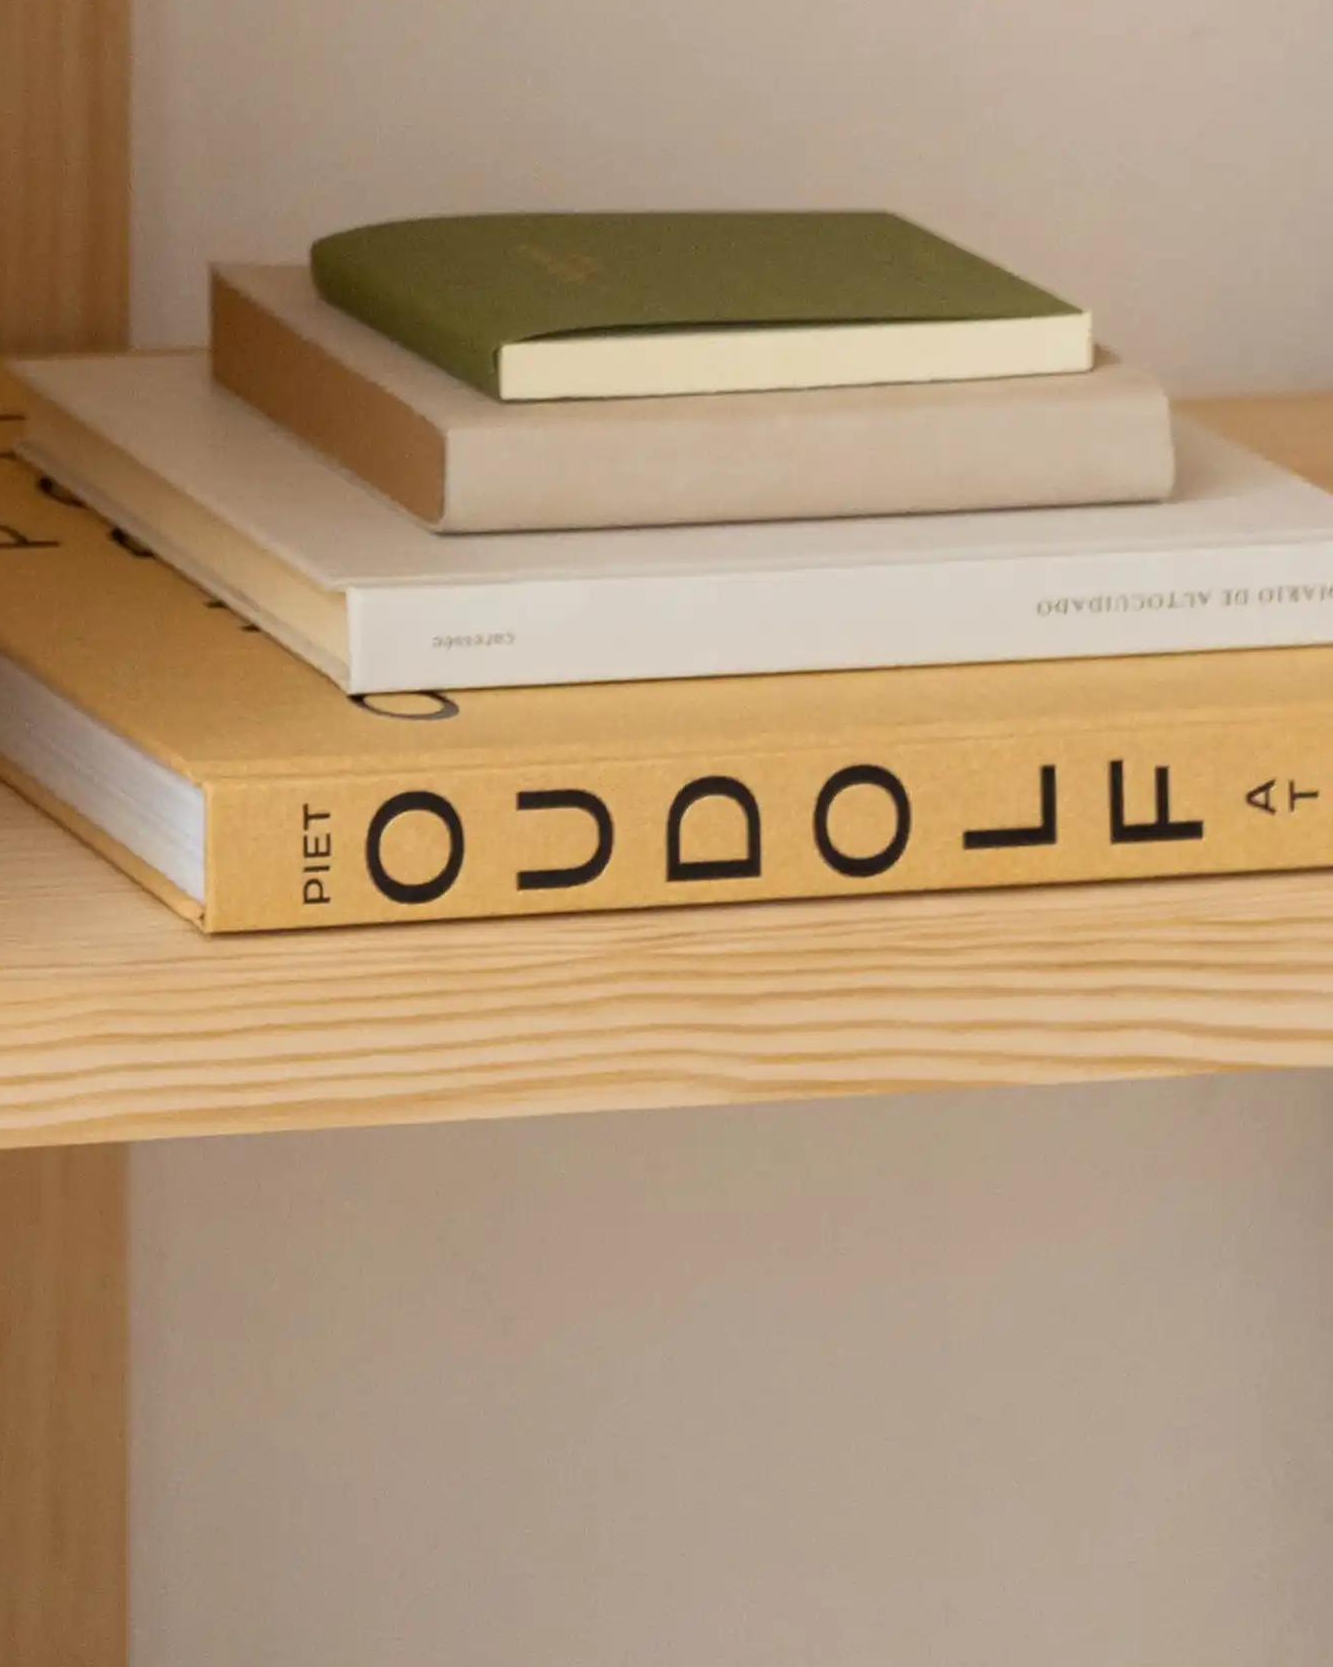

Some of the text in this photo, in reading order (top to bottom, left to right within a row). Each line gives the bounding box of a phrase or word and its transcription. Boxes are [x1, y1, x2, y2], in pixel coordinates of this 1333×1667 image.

[1036, 589, 1212, 616] AUTOCUIDADO
[1222, 587, 1249, 607] DE
[302, 803, 331, 905] PIET
[365, 759, 1204, 905] OUDOLF
